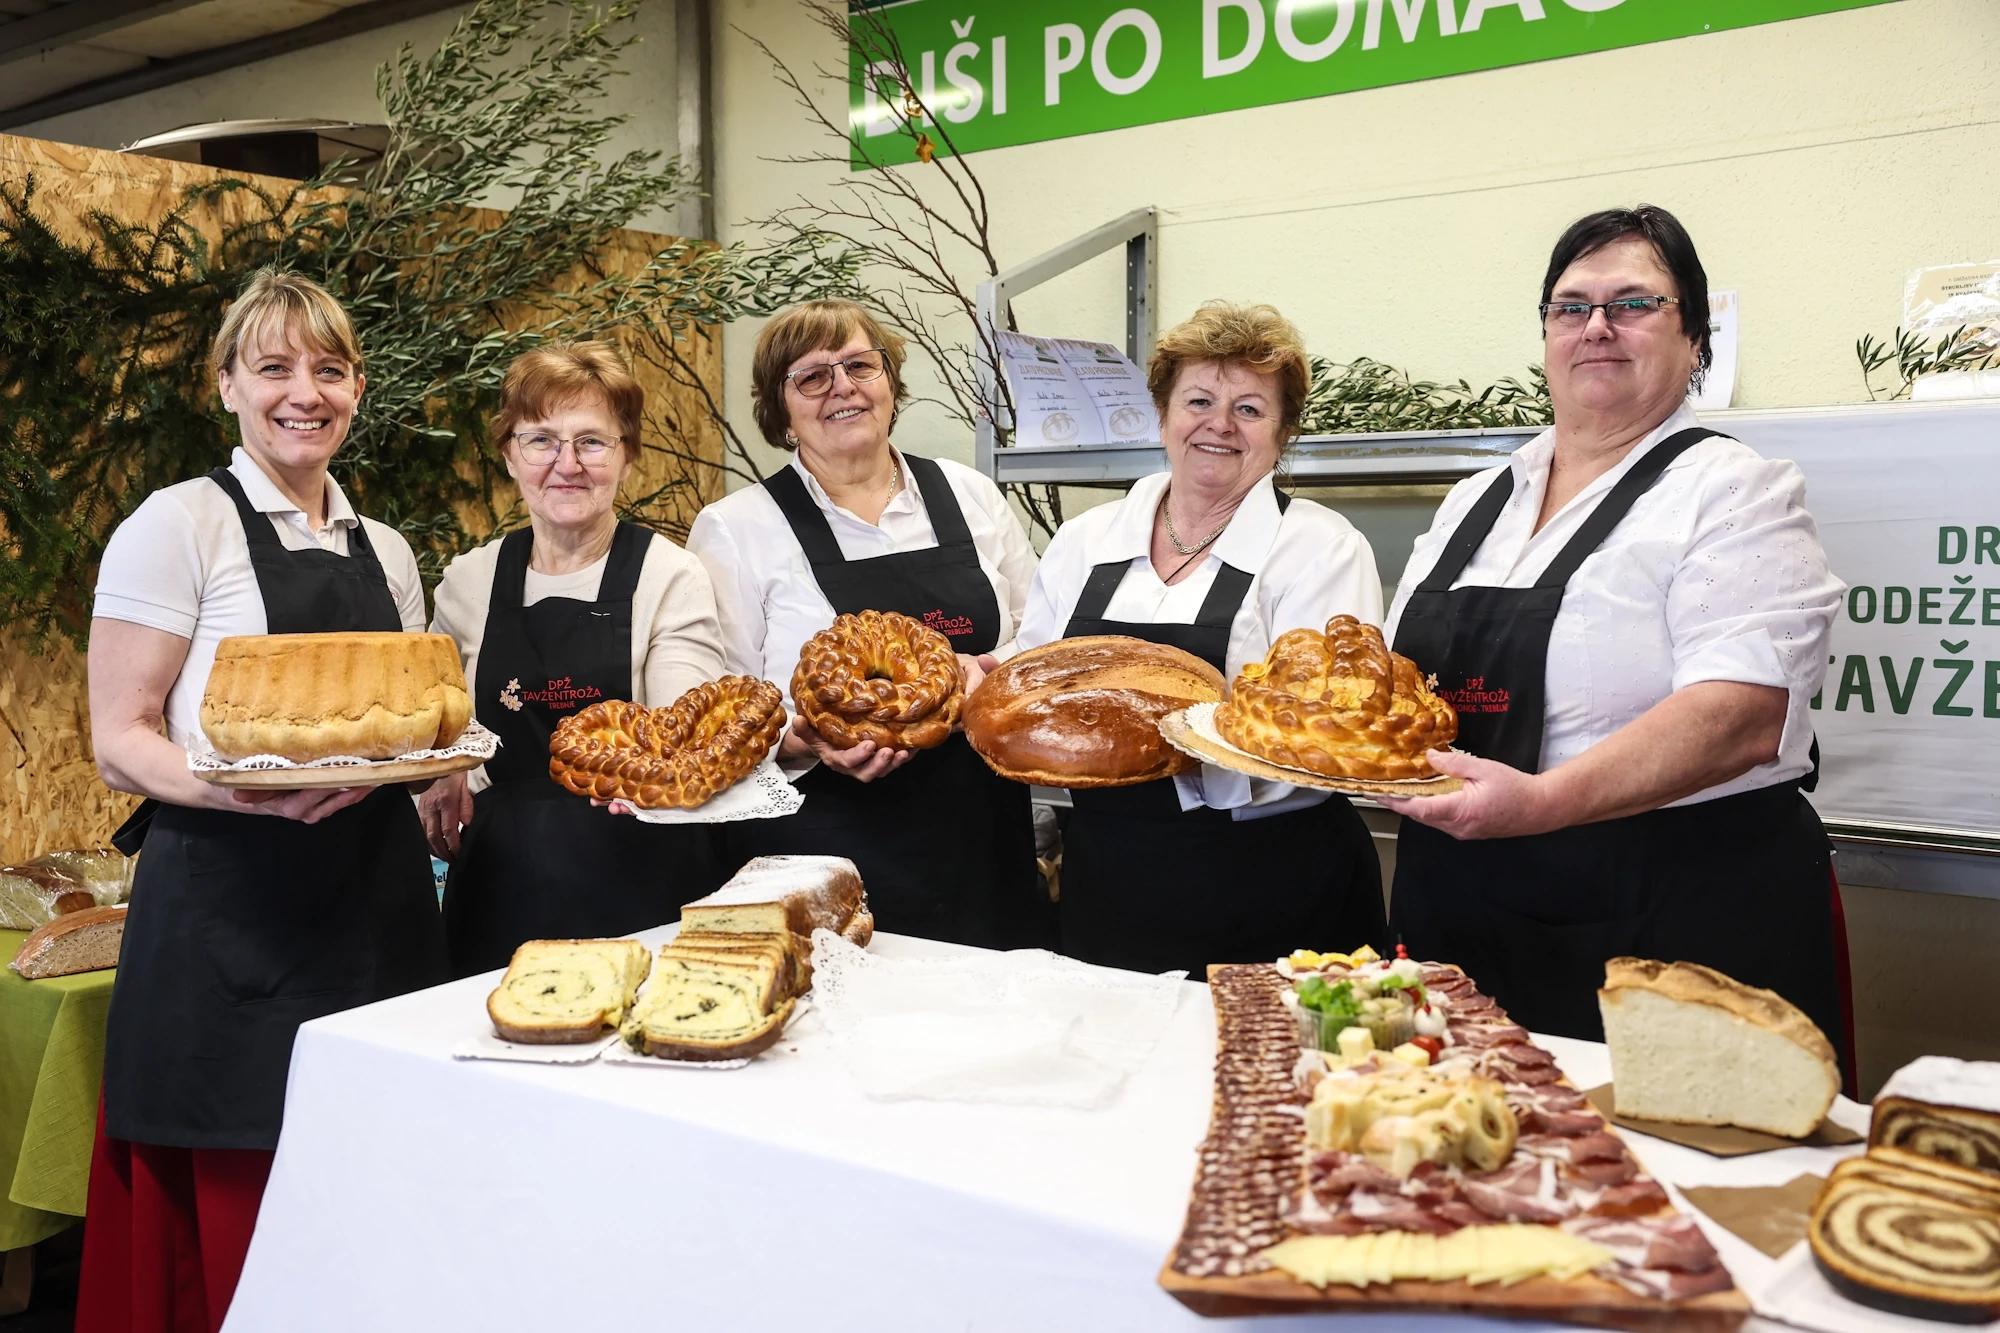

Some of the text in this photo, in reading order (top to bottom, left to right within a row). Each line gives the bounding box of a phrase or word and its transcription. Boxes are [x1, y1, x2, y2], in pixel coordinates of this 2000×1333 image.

[864, 15, 1007, 138] DIŠI
[1044, 8, 1163, 107] PO
[1847, 574, 2000, 626] ODEŽE
[923, 609, 945, 622] DPŽ
[548, 676, 572, 690] DPŽ
[1466, 675, 1485, 690] DPŽ
[521, 685, 601, 701] TAVŽENTROŽA
[1438, 688, 1509, 702] TAVŽENTROŽA
